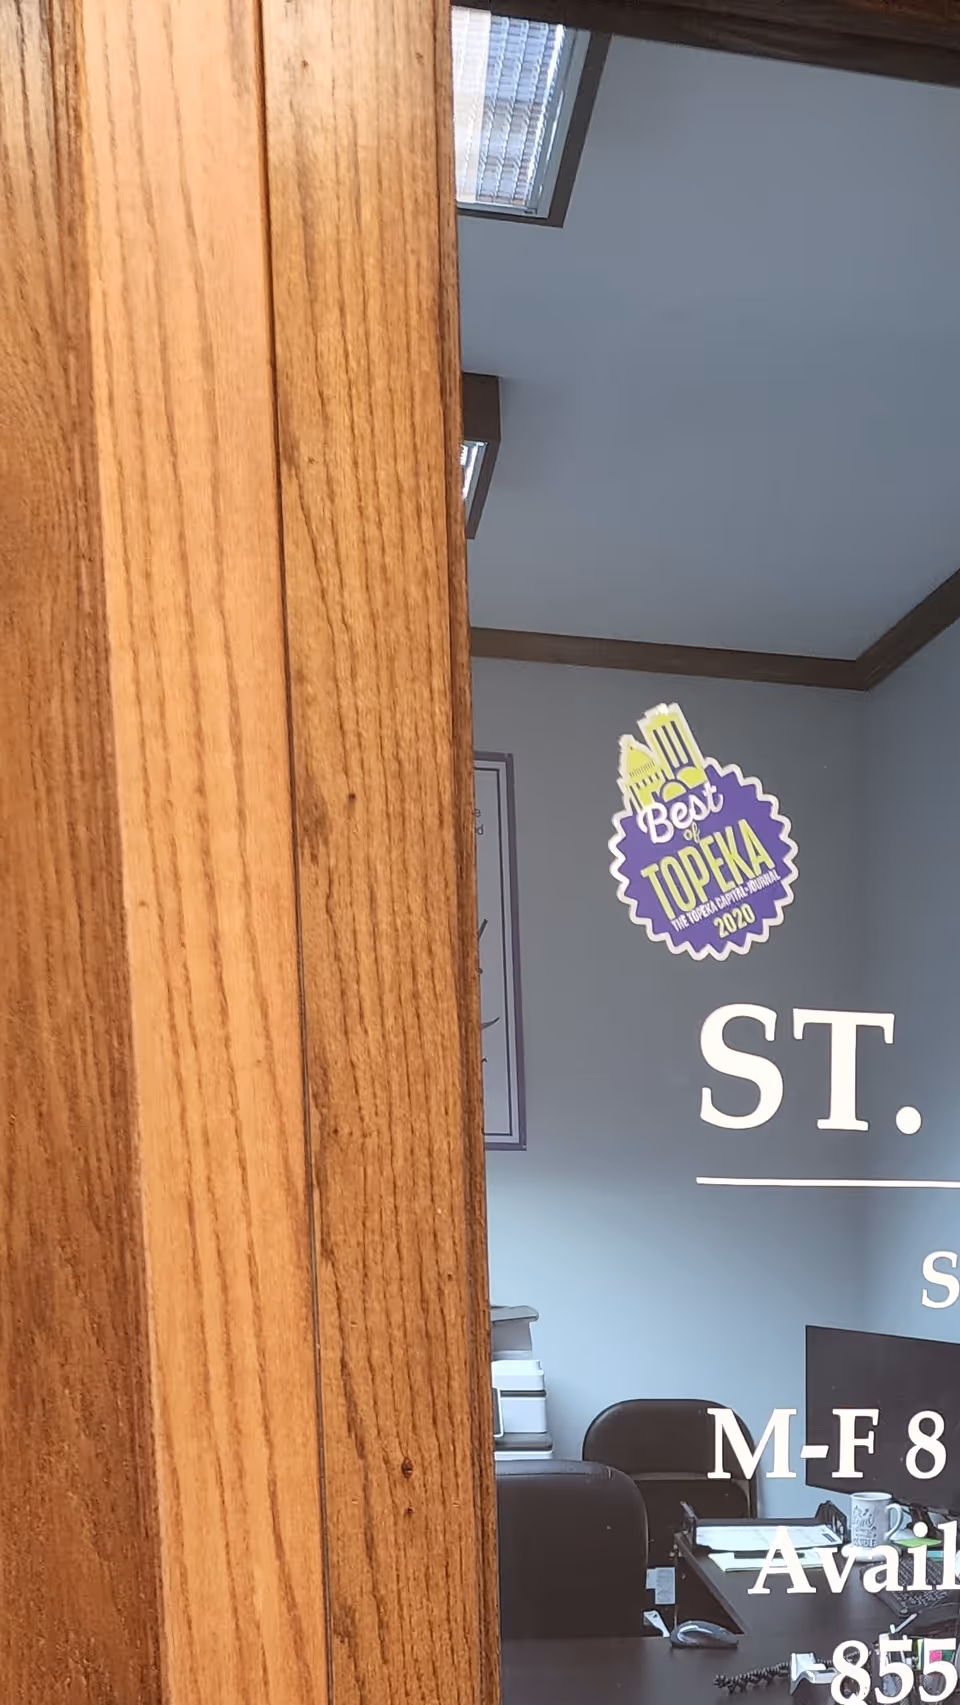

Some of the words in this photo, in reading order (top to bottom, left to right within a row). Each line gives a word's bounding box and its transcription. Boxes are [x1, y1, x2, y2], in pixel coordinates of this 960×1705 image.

[635, 780, 724, 844] Best
[682, 823, 701, 844] of
[640, 818, 775, 920] TOPEKA
[670, 913, 689, 933] THE
[686, 900, 718, 925] TOPEKA
[712, 902, 757, 939] 2020
[700, 1003, 922, 1135] ST.
[706, 1407, 880, 1481] M-F
[906, 1410, 948, 1480] 8
